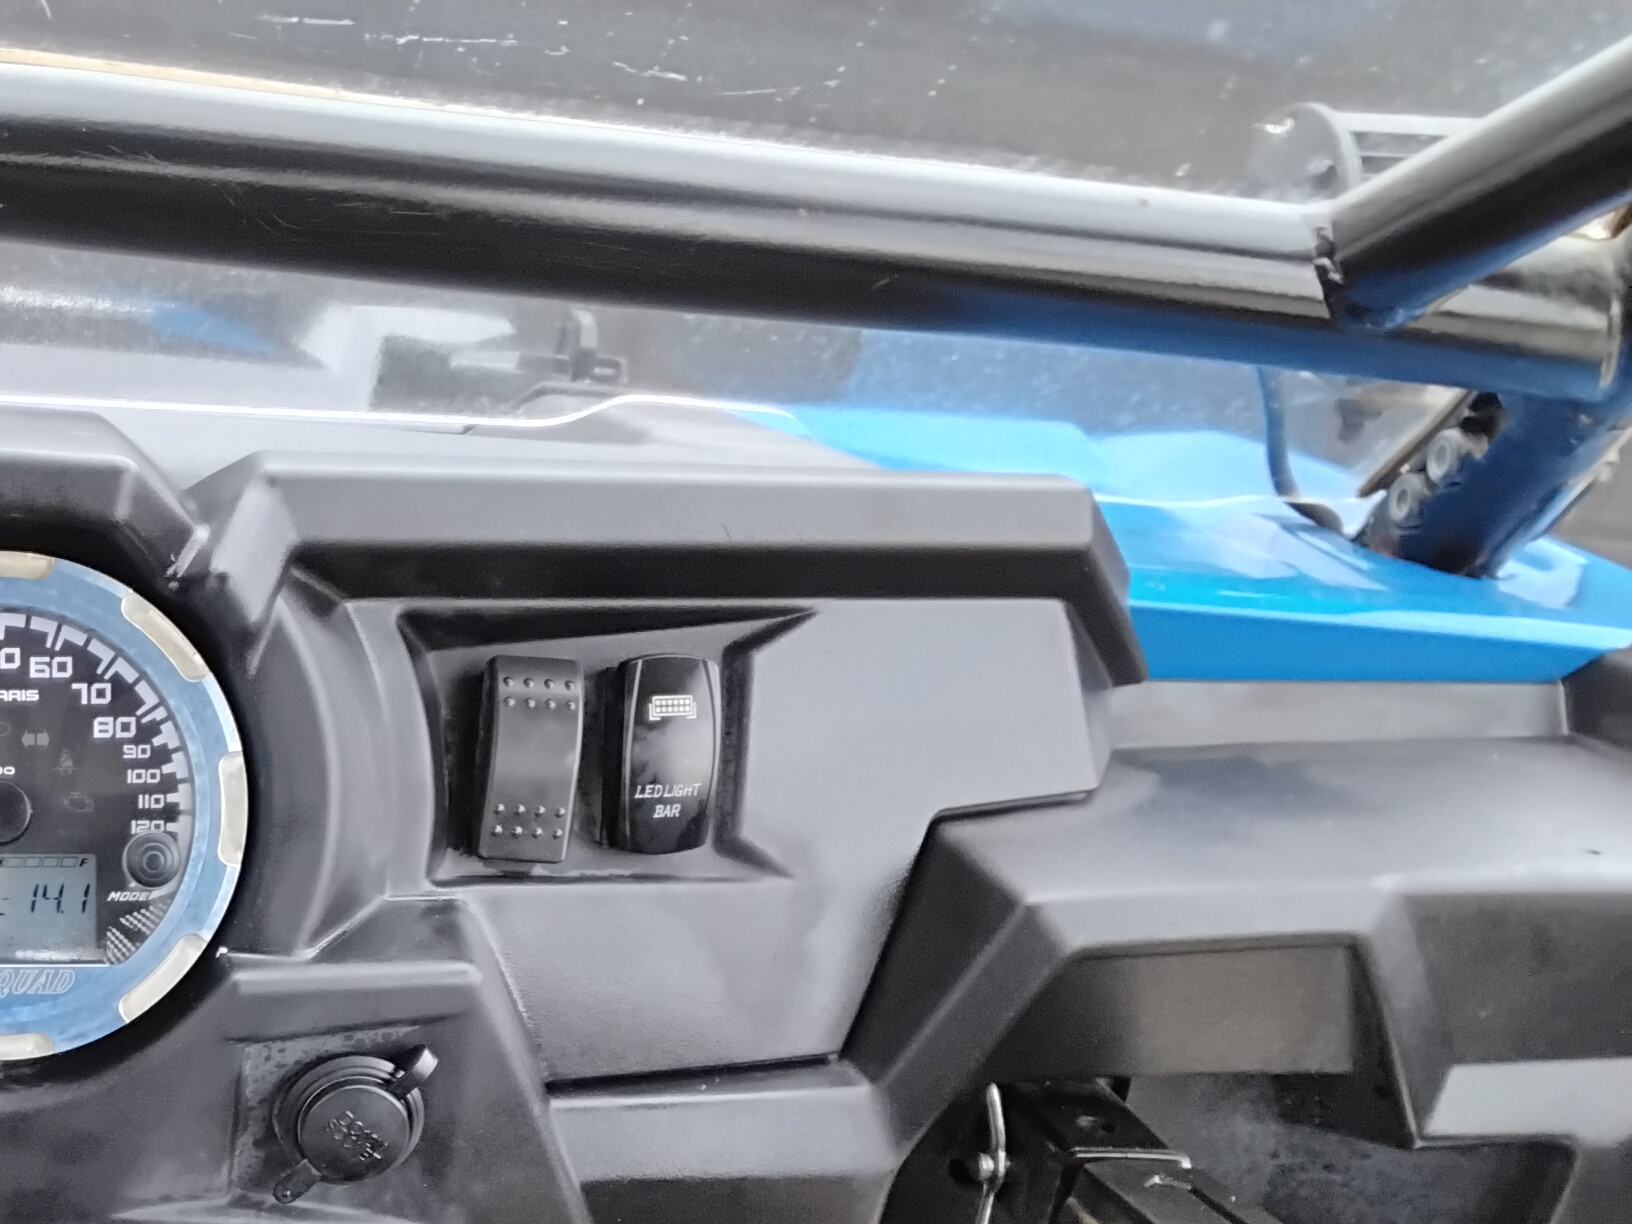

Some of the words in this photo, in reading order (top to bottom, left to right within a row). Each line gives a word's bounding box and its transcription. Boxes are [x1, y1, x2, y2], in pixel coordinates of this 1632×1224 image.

[29, 656, 73, 678] 60
[71, 682, 112, 705] 70
[93, 716, 136, 739] 80
[123, 744, 151, 759] 90
[127, 769, 161, 784] 100
[634, 784, 663, 798] LED
[663, 783, 702, 798] LIGHT
[138, 794, 165, 809] 110
[652, 804, 681, 819] BAR
[131, 819, 165, 835] 120
[79, 857, 89, 868] F
[30, 883, 91, 914] 14.1
[107, 891, 151, 902] MODE
